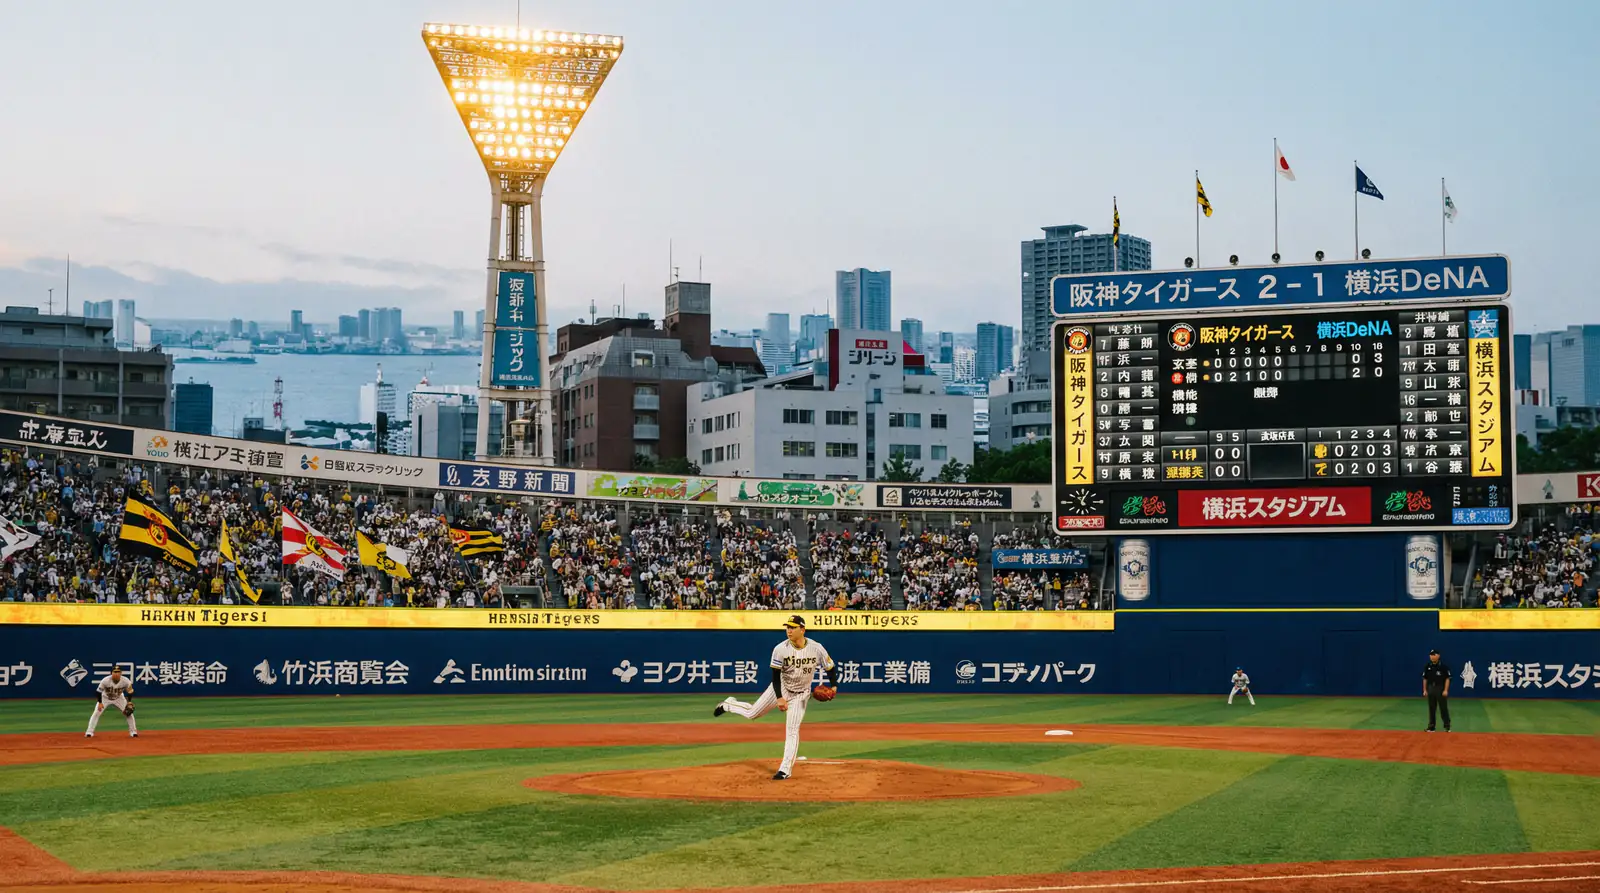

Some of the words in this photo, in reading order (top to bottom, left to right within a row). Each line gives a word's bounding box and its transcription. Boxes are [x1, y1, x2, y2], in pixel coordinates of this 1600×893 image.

[1070, 278, 1241, 308] 阪神タイガース
[1345, 265, 1490, 296] 横浜DeNA
[1200, 324, 1295, 344] 阪神タイガース
[1317, 320, 1393, 339] 横浜DeNA
[1230, 347, 1236, 355] 2
[1259, 346, 1266, 354] 4
[1321, 344, 1327, 352] 8
[1405, 345, 1411, 355] 1
[1424, 343, 1436, 355] 田
[1214, 358, 1222, 369] 0
[1229, 357, 1237, 368] 0
[1244, 357, 1252, 367] 0
[1259, 356, 1267, 367] 0
[1274, 356, 1282, 367] 0
[1352, 354, 1360, 364] 0
[1374, 353, 1383, 363] 3
[1101, 372, 1108, 382] 2
[1214, 372, 1222, 382] 0
[1229, 372, 1237, 382] 2
[1245, 371, 1251, 381] 1
[1259, 371, 1267, 381] 0
[1274, 370, 1282, 380] 0
[1352, 367, 1360, 378] 2
[1375, 367, 1383, 377] 0
[1405, 378, 1412, 388] 9
[1424, 377, 1436, 389] 山
[1101, 387, 1108, 398] 8
[1101, 404, 1108, 414] 0
[1475, 342, 1495, 472] 横浜スタジアム
[1070, 357, 1087, 480] 阪神タイガース
[1406, 412, 1413, 421] 2
[1232, 433, 1239, 441] 5
[1336, 430, 1341, 439] 1
[1350, 429, 1358, 438] 2
[1366, 429, 1374, 438] 3
[1383, 428, 1391, 438] 4
[1215, 448, 1224, 459] 0
[1231, 447, 1240, 459] 0
[1334, 445, 1344, 457] 0
[1351, 444, 1358, 456] 2
[1366, 444, 1375, 456] 0
[1382, 444, 1391, 456] 3
[1215, 466, 1224, 477] 0
[1231, 465, 1240, 476] 0
[1335, 463, 1344, 475] 0
[1351, 463, 1359, 474] 2
[1367, 462, 1375, 474] 0
[1383, 462, 1391, 474] 3
[1406, 463, 1412, 473] 1
[1425, 461, 1438, 474] 谷
[1202, 496, 1347, 520] 横浜スタジアム
[783, 655, 817, 668] Tigers
